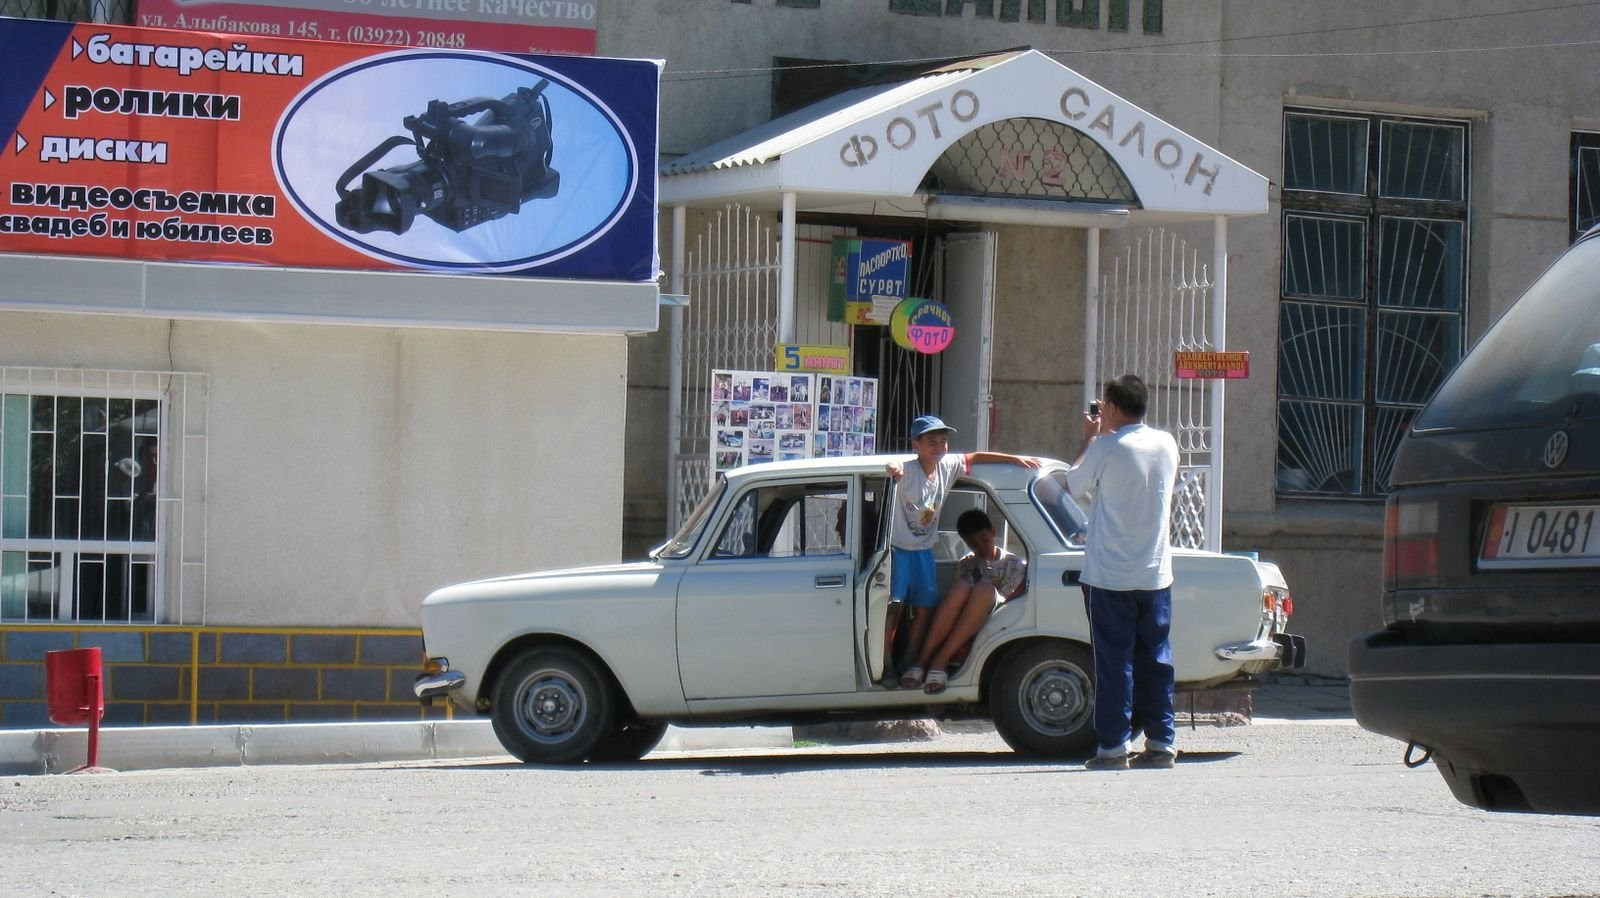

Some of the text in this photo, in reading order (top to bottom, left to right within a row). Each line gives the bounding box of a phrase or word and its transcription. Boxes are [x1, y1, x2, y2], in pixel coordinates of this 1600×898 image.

[476, 0, 596, 21] качество
[141, 13, 466, 48] ул. Алыбакова 145, т. (03922) 20848
[87, 34, 304, 76] батарейки
[63, 85, 241, 121] ролики
[40, 136, 168, 165] диски
[839, 87, 1221, 197] ФОТО САЛОН
[1042, 149, 1068, 187] 2
[11, 182, 276, 218] видеосъемка
[0, 213, 274, 245] свадеб и юбилеев
[911, 304, 952, 327] СРОЧНОЕ
[911, 327, 949, 347] ФОТО
[784, 346, 801, 370] 5
[1196, 369, 1225, 378] ФОТО
[1526, 510, 1594, 554] 0481
